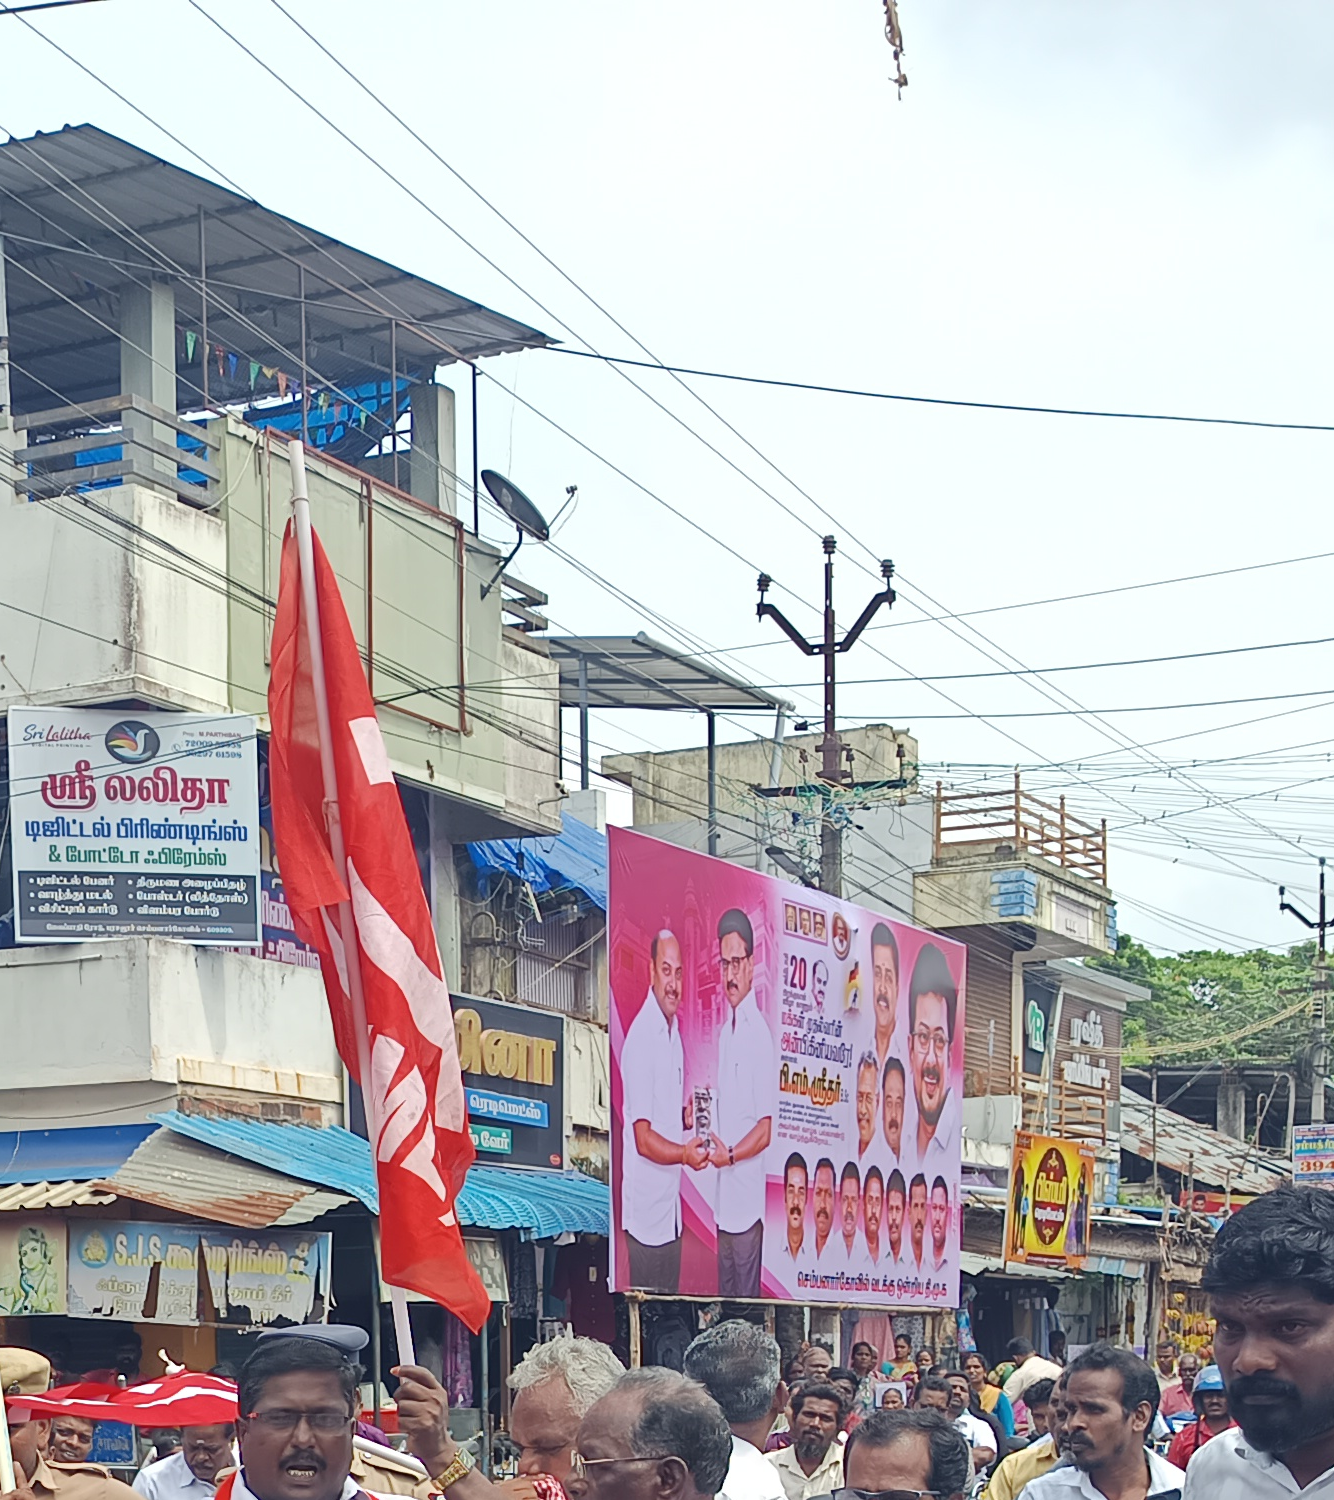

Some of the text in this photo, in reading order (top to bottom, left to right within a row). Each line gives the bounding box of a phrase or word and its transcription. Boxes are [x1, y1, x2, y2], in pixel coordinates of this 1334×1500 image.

[23, 723, 92, 743] Sri Lalitha
[41, 760, 230, 815] ஸ்ரீ லலிதா
[25, 816, 112, 843] டிஜிட்டல்
[117, 817, 249, 846] பிரிண்டிங்ஸ்
[49, 844, 228, 868] & போட்டோ ஃபிரேம்ஸ்
[790, 955, 807, 991] 20
[798, 1269, 869, 1292] செம்பனார்கோவில்
[871, 1274, 895, 1297] வடக்கு
